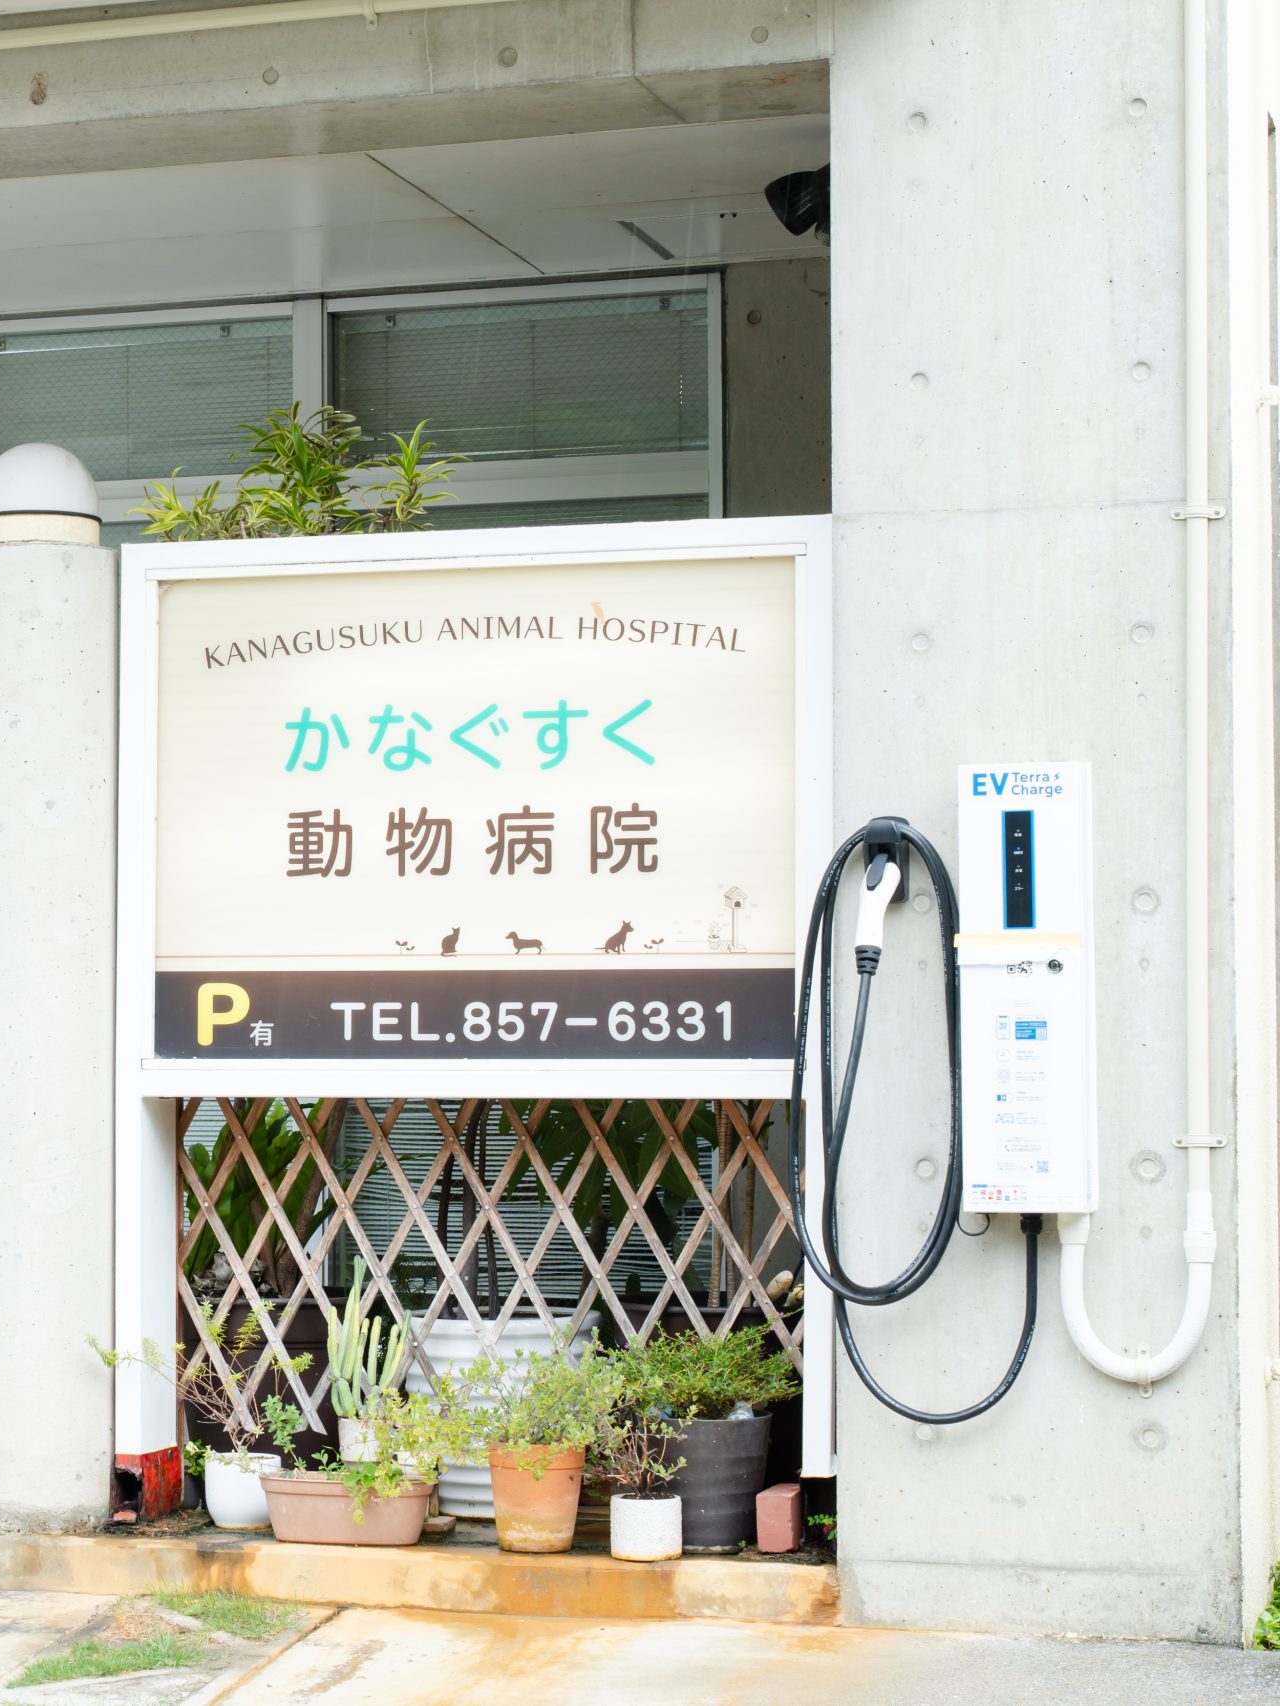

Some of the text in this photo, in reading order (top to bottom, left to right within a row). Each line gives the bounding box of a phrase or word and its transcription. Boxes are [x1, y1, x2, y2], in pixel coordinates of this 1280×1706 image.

[205, 615, 746, 669] KANAGUSUKU ANIMAL HOSPITAL
[285, 700, 656, 773] かなぐすく
[972, 772, 1050, 796] EV Terra
[1011, 785, 1063, 798] Charge
[286, 803, 659, 879] 動物病院
[197, 983, 275, 1047] P 有
[330, 1001, 733, 1043] TEL.857-6331
